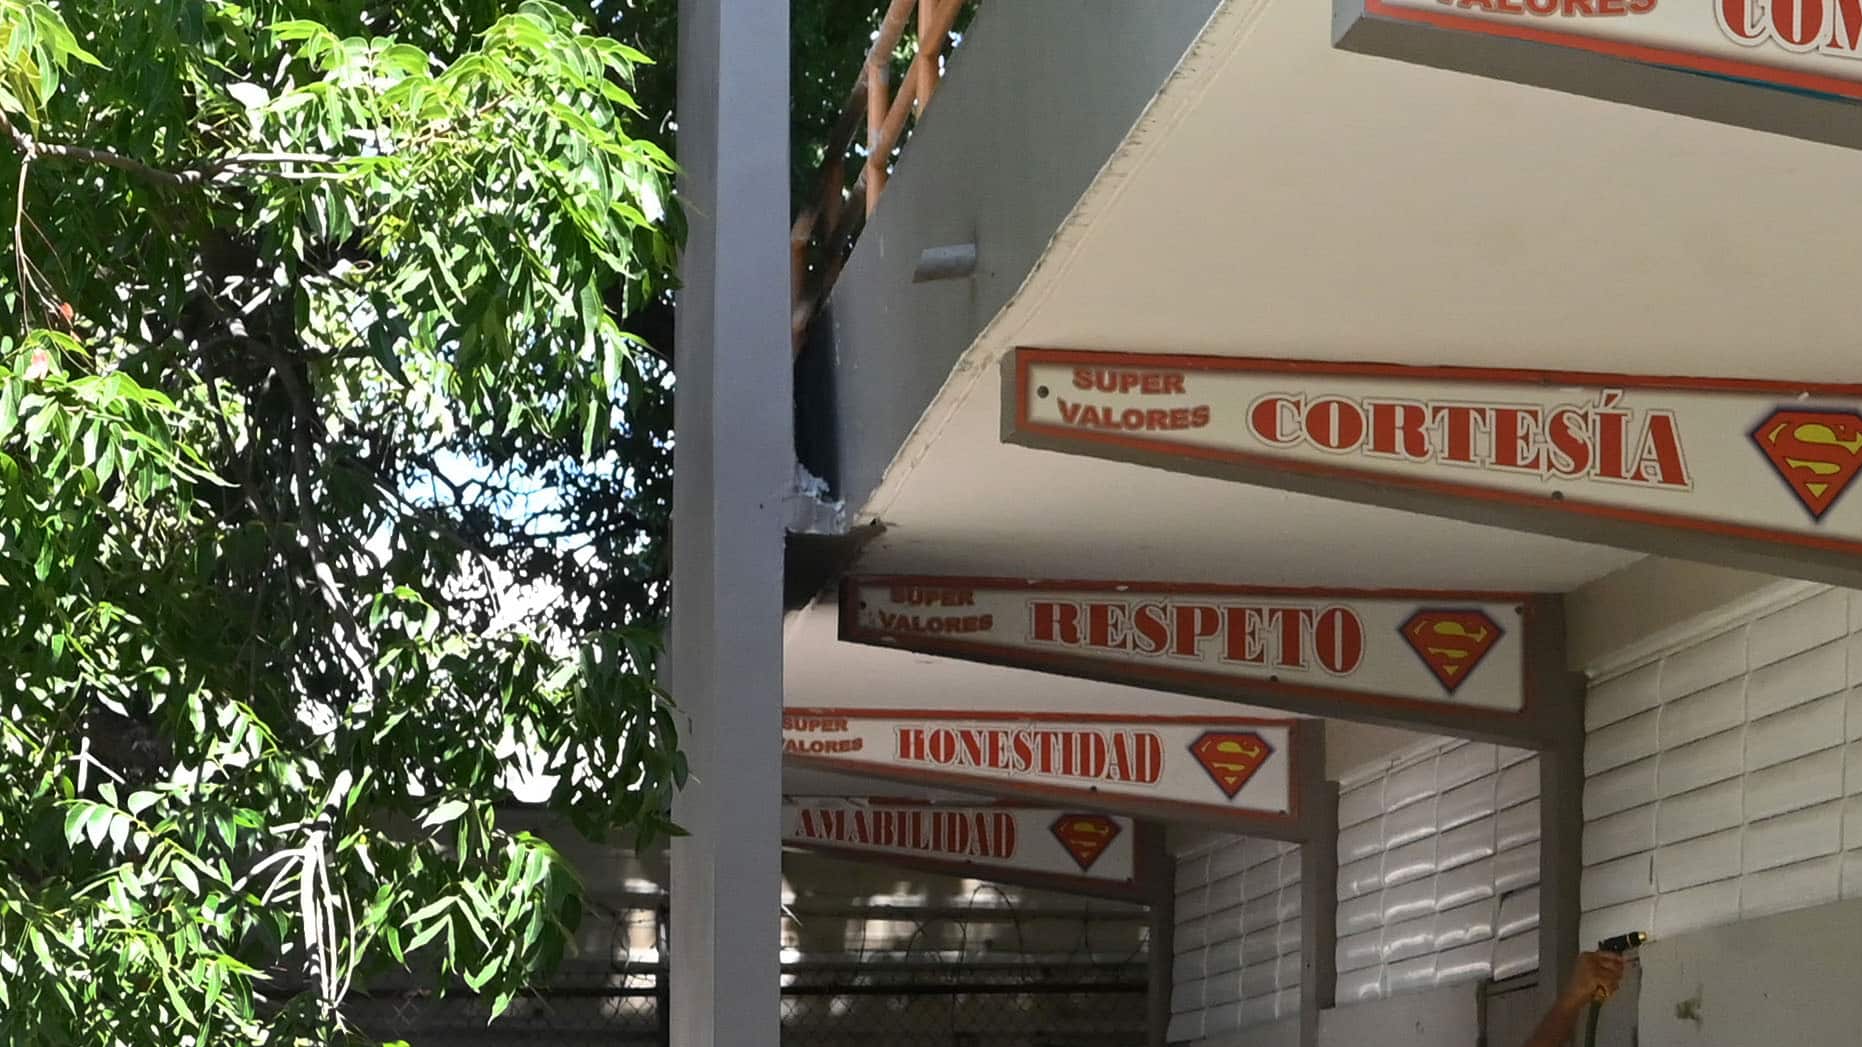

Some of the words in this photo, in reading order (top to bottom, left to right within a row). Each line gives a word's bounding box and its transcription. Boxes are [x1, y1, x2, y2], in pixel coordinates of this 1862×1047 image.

[1073, 368, 1186, 394] SUPER
[1057, 398, 1211, 430] VALORES
[1248, 391, 1691, 489] CORTESÍA
[879, 611, 993, 632] VALORES
[1030, 601, 1365, 675] RESPETO
[784, 717, 848, 732] SUPER
[783, 738, 863, 753] ALORES
[897, 727, 1164, 784] HONESTIDAD
[795, 808, 1016, 859] AMABILIDAD
